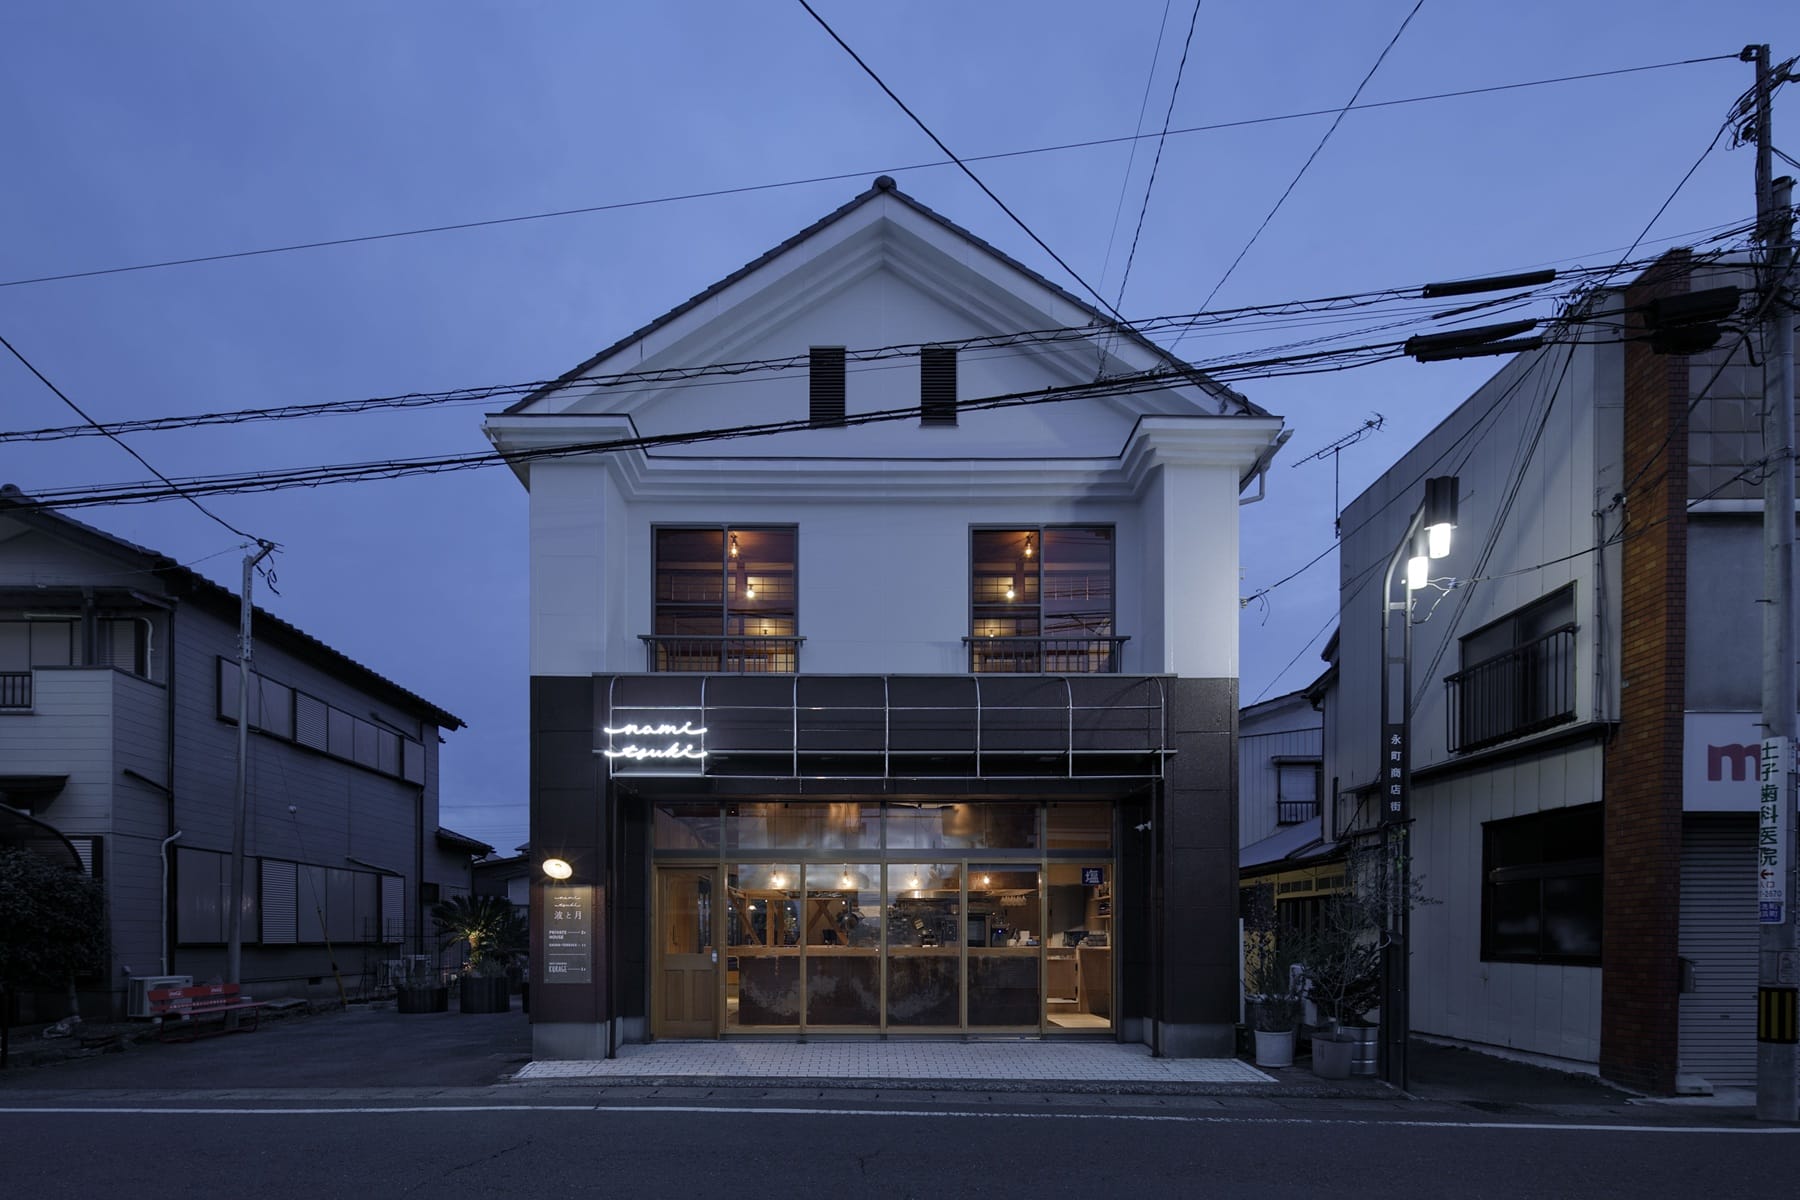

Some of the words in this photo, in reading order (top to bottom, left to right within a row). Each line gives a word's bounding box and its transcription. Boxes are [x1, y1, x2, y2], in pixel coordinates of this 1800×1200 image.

[603, 720, 708, 735] nami
[603, 741, 708, 760] tsuki
[1390, 734, 1401, 812] 永町商店街
[554, 910, 582, 920] 波と月
